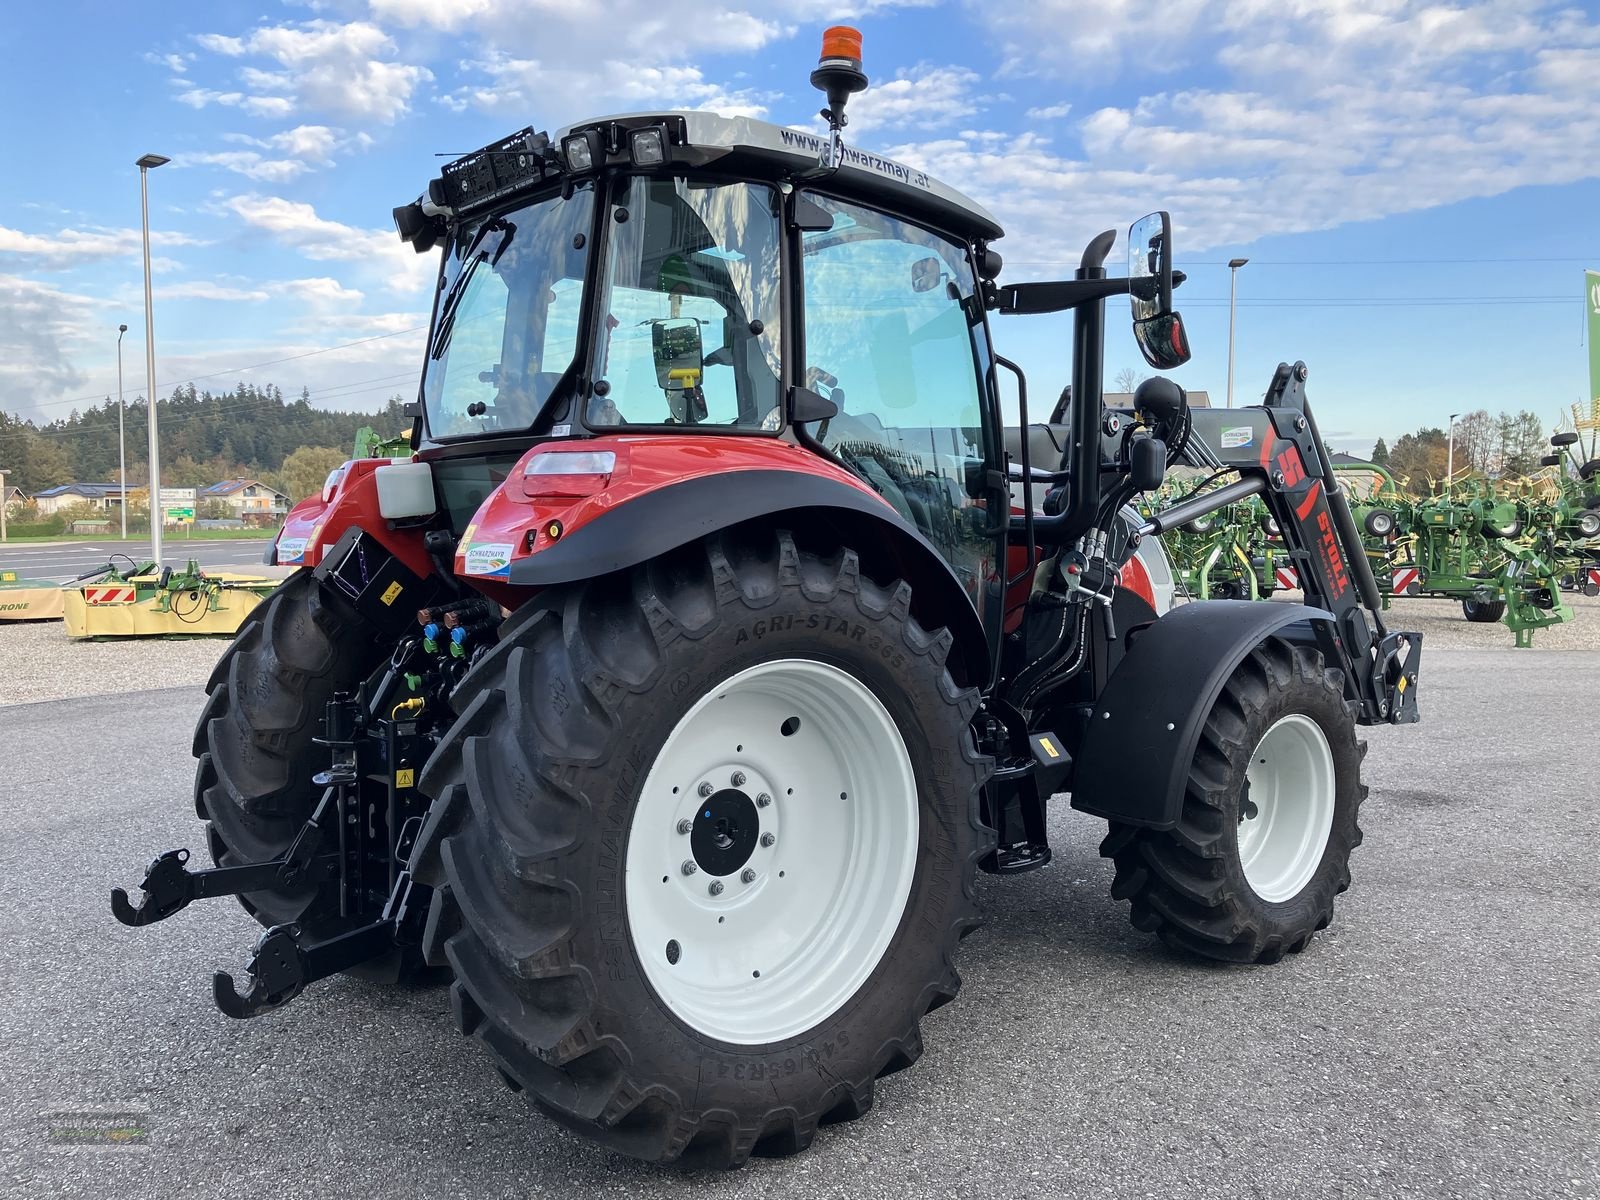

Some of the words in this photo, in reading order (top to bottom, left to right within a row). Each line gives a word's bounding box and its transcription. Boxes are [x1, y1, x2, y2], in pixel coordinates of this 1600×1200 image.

[780, 129, 909, 182] www.shwarzmay
[1316, 510, 1348, 595] STOLL
[0, 602, 30, 611] RONE
[735, 614, 867, 645] AGRI-STAR
[868, 636, 908, 669] 365
